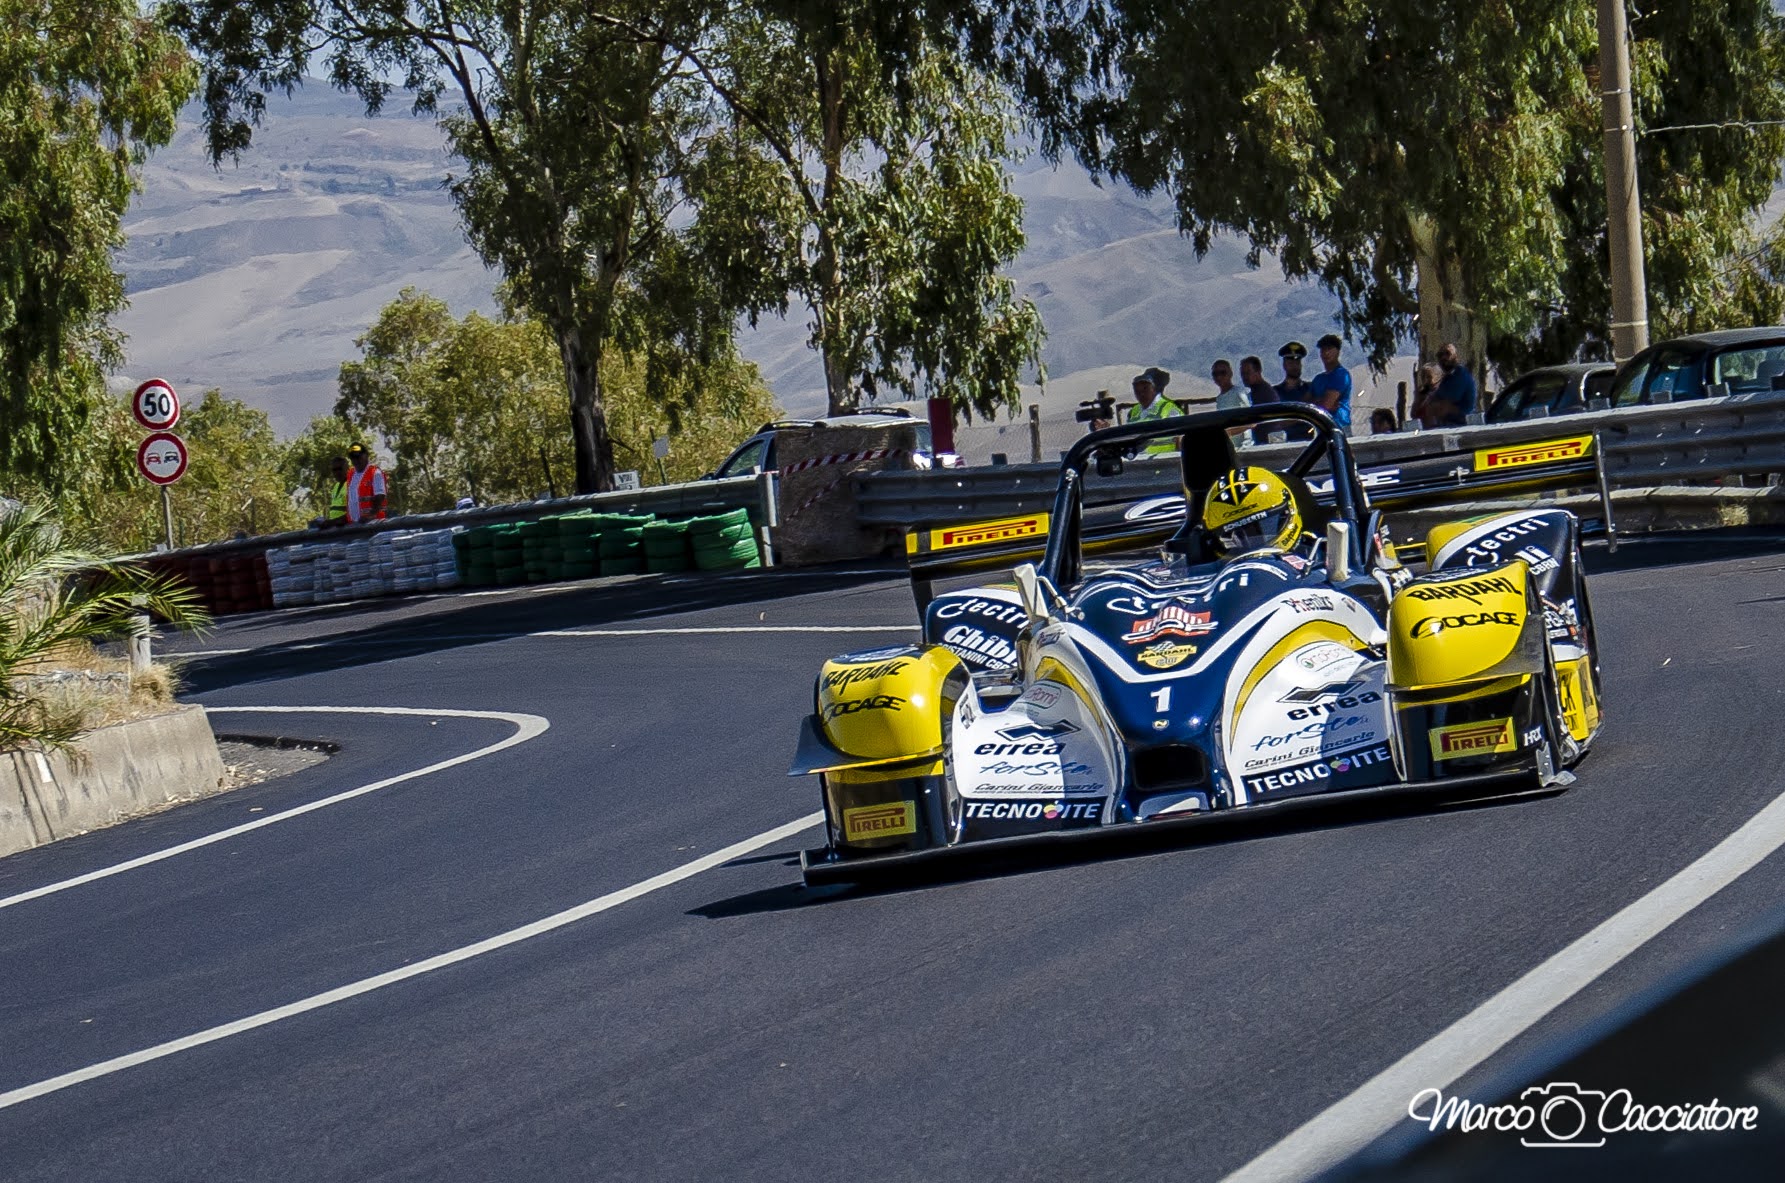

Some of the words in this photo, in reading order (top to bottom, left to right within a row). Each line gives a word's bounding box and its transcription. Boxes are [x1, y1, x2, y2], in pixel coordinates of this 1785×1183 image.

[144, 393, 170, 417] 50
[1488, 442, 1581, 466] PIRELLI
[944, 520, 1037, 545] PIRELLI
[1529, 558, 1560, 576] CBRN
[1407, 577, 1522, 605] BARDAHL
[1151, 686, 1172, 713] 1
[1287, 692, 1381, 720] errea
[974, 742, 1066, 756] errea
[1245, 752, 1293, 768] Carini
[1299, 731, 1376, 756] Giancarlo
[1441, 725, 1508, 752] PIRELLI
[975, 783, 1025, 791] Carini
[1028, 783, 1103, 791] Giancarlo
[851, 808, 905, 833] PIRELLI
